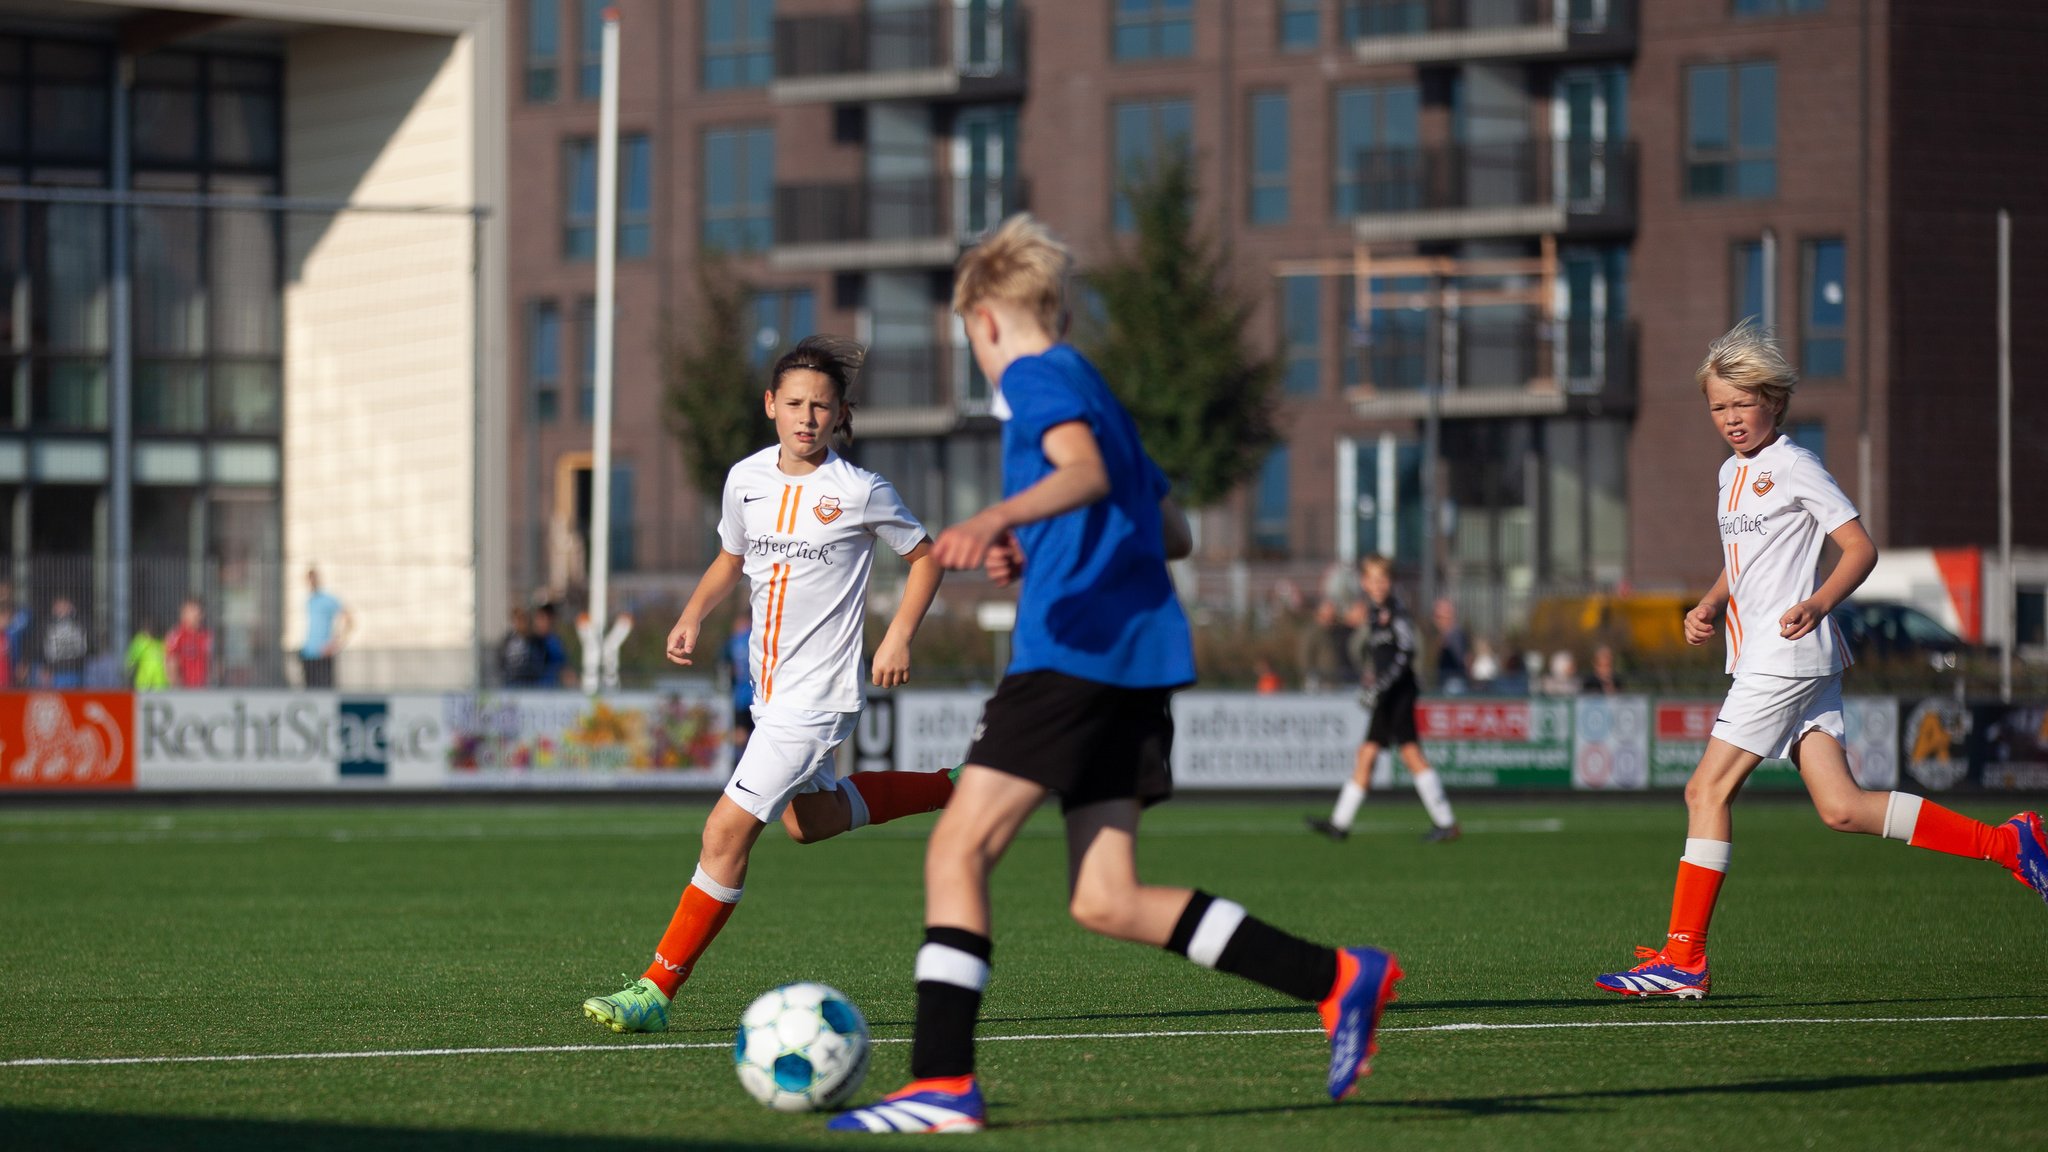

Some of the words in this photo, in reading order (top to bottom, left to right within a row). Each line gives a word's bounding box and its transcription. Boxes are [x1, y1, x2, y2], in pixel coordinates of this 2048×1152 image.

[1427, 705, 1530, 736] SPAR
[1187, 746, 1360, 776] accountan
[654, 951, 687, 975] BVC
